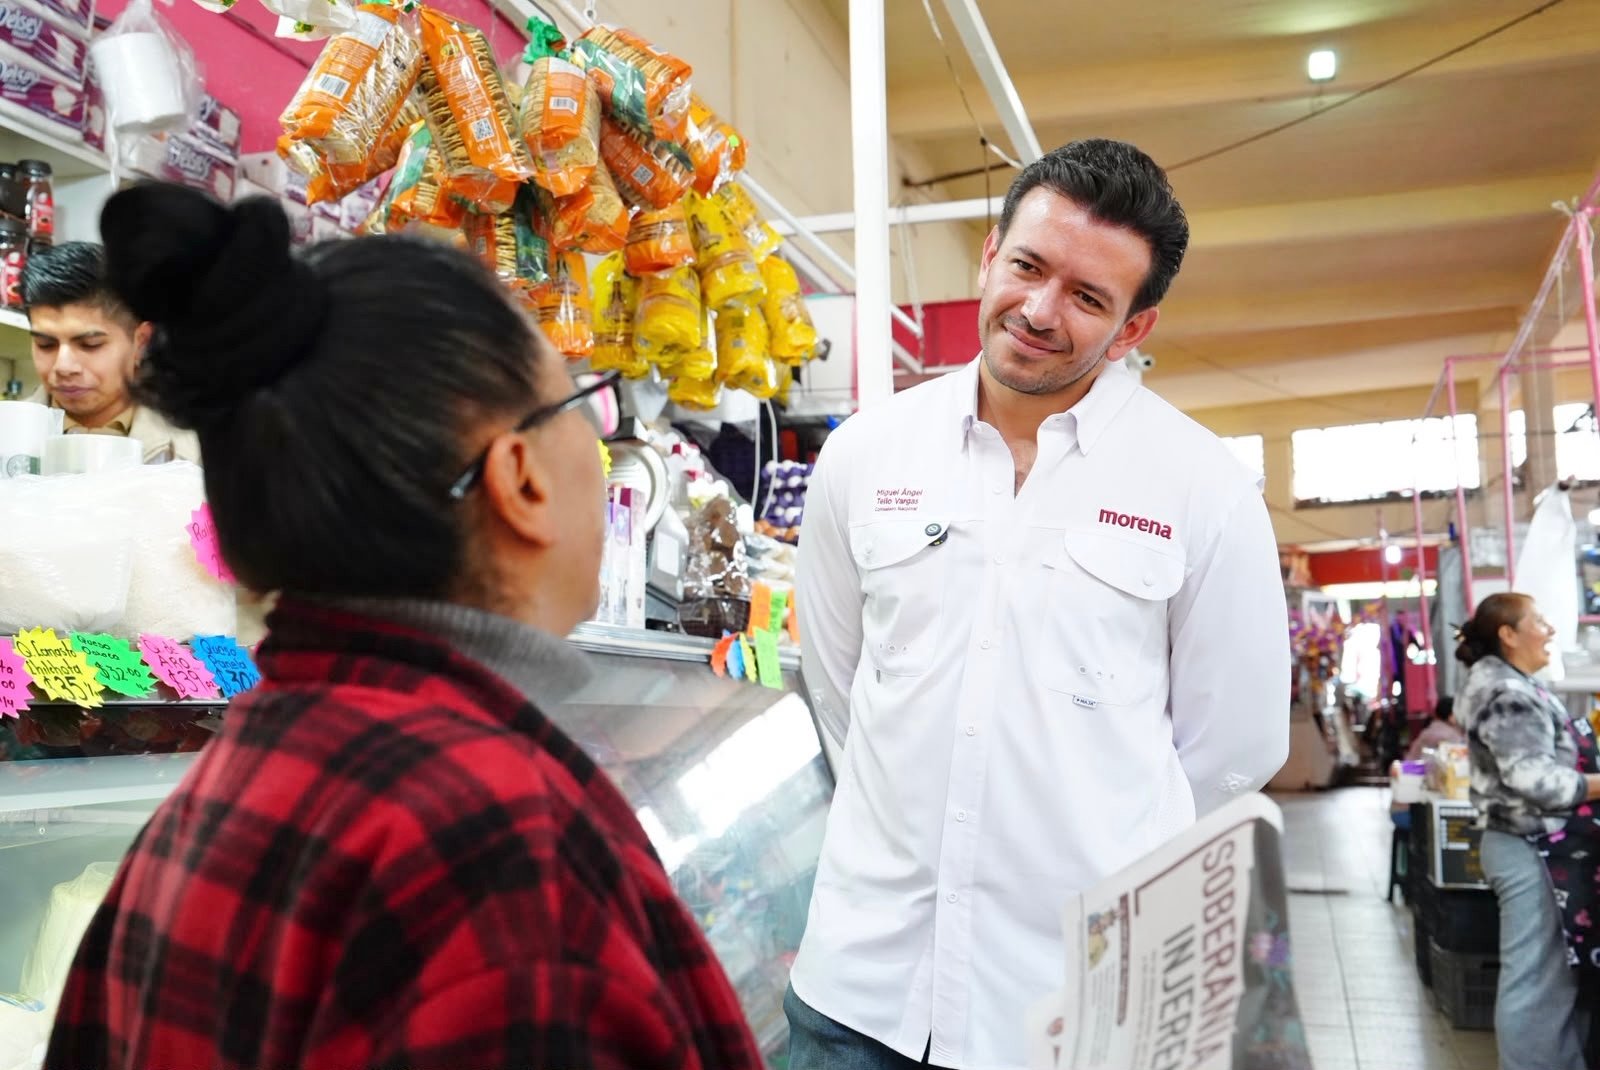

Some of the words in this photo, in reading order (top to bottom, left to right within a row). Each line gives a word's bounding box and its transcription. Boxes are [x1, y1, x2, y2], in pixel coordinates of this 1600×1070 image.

[901, 488, 924, 496] Ángel
[1098, 508, 1173, 540] morena
[200, 639, 237, 657] Queso
